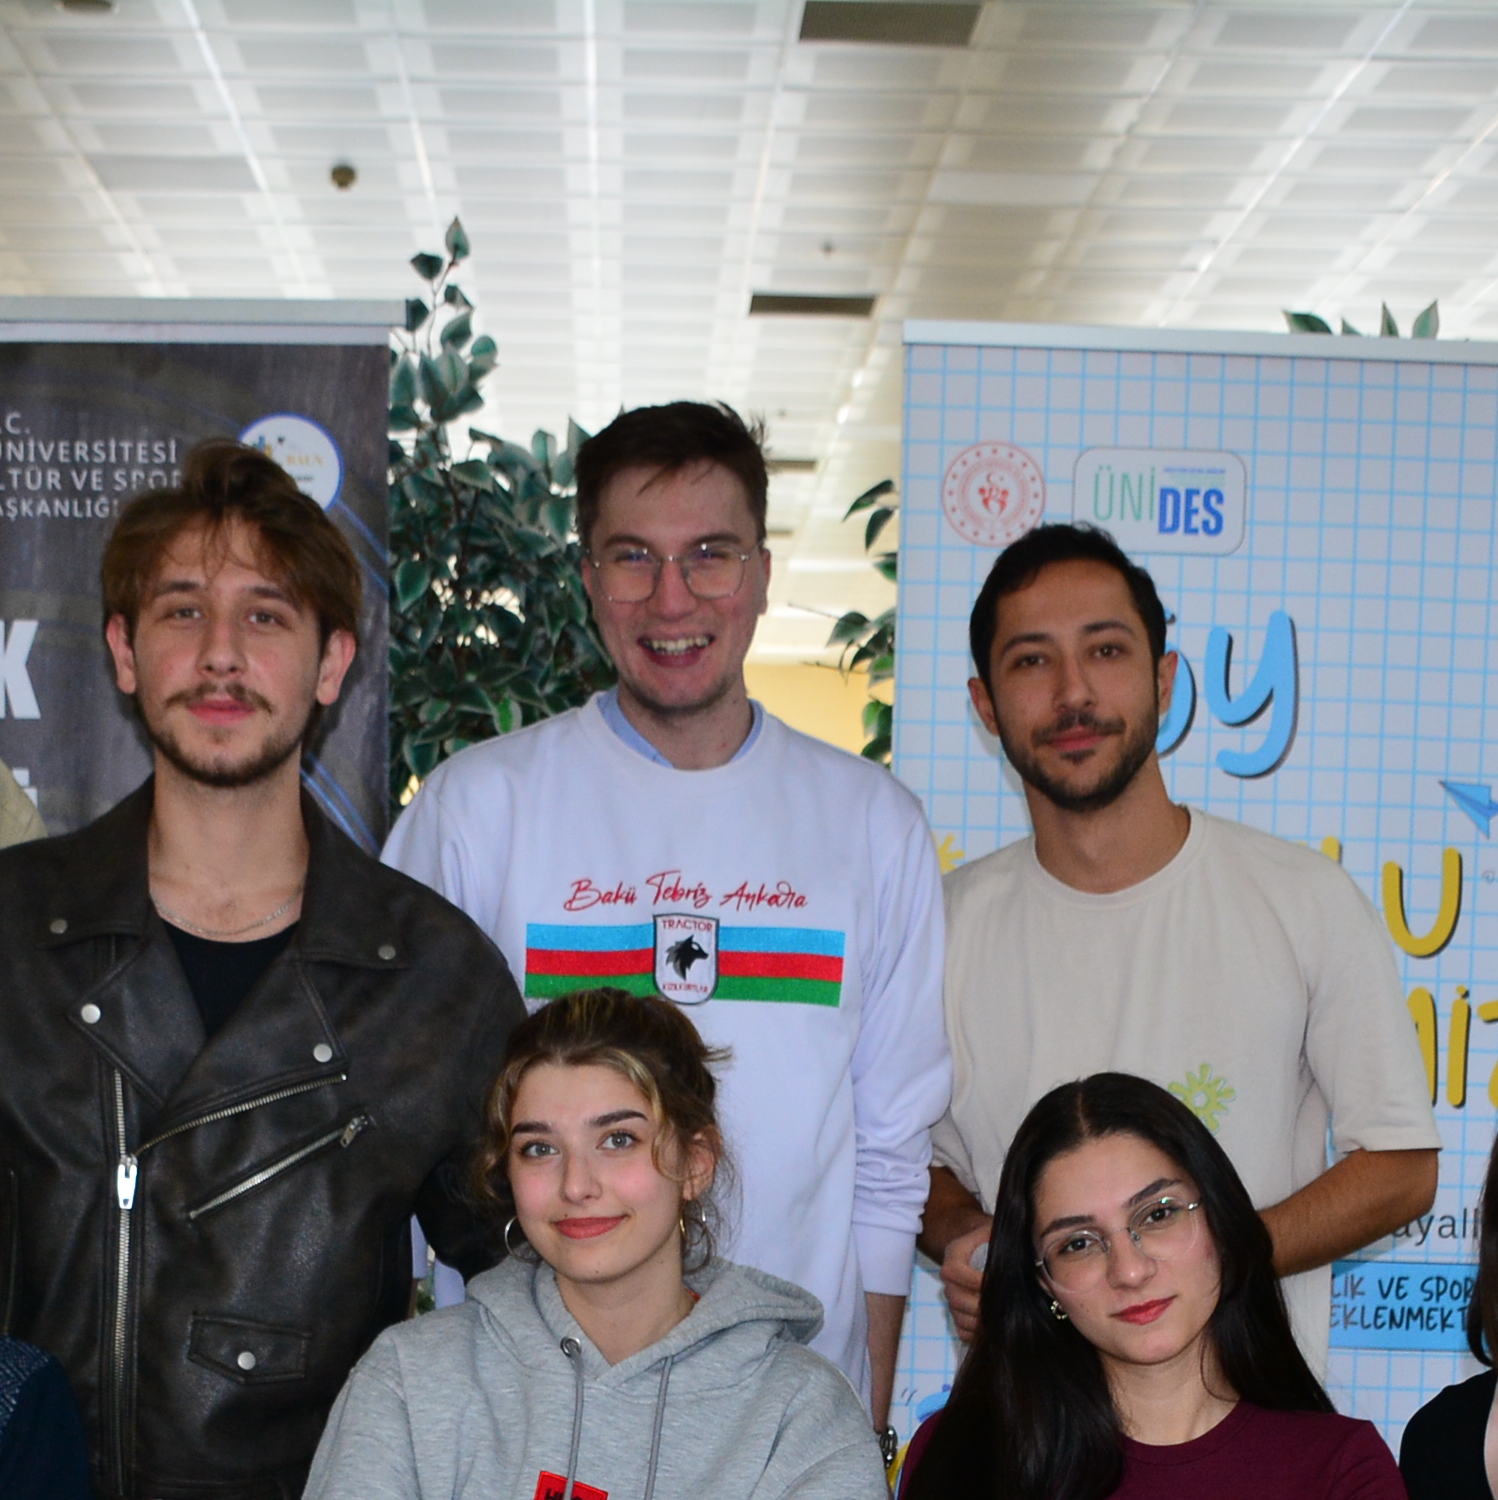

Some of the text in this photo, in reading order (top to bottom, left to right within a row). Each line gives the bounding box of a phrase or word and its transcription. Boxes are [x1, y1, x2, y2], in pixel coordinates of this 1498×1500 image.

[71, 470, 103, 491] VE
[1157, 486, 1225, 537] DES
[661, 919, 713, 932] TRACTOR
[1377, 1276, 1411, 1301] VE
[1329, 1304, 1469, 1334] EKLENMEKT
